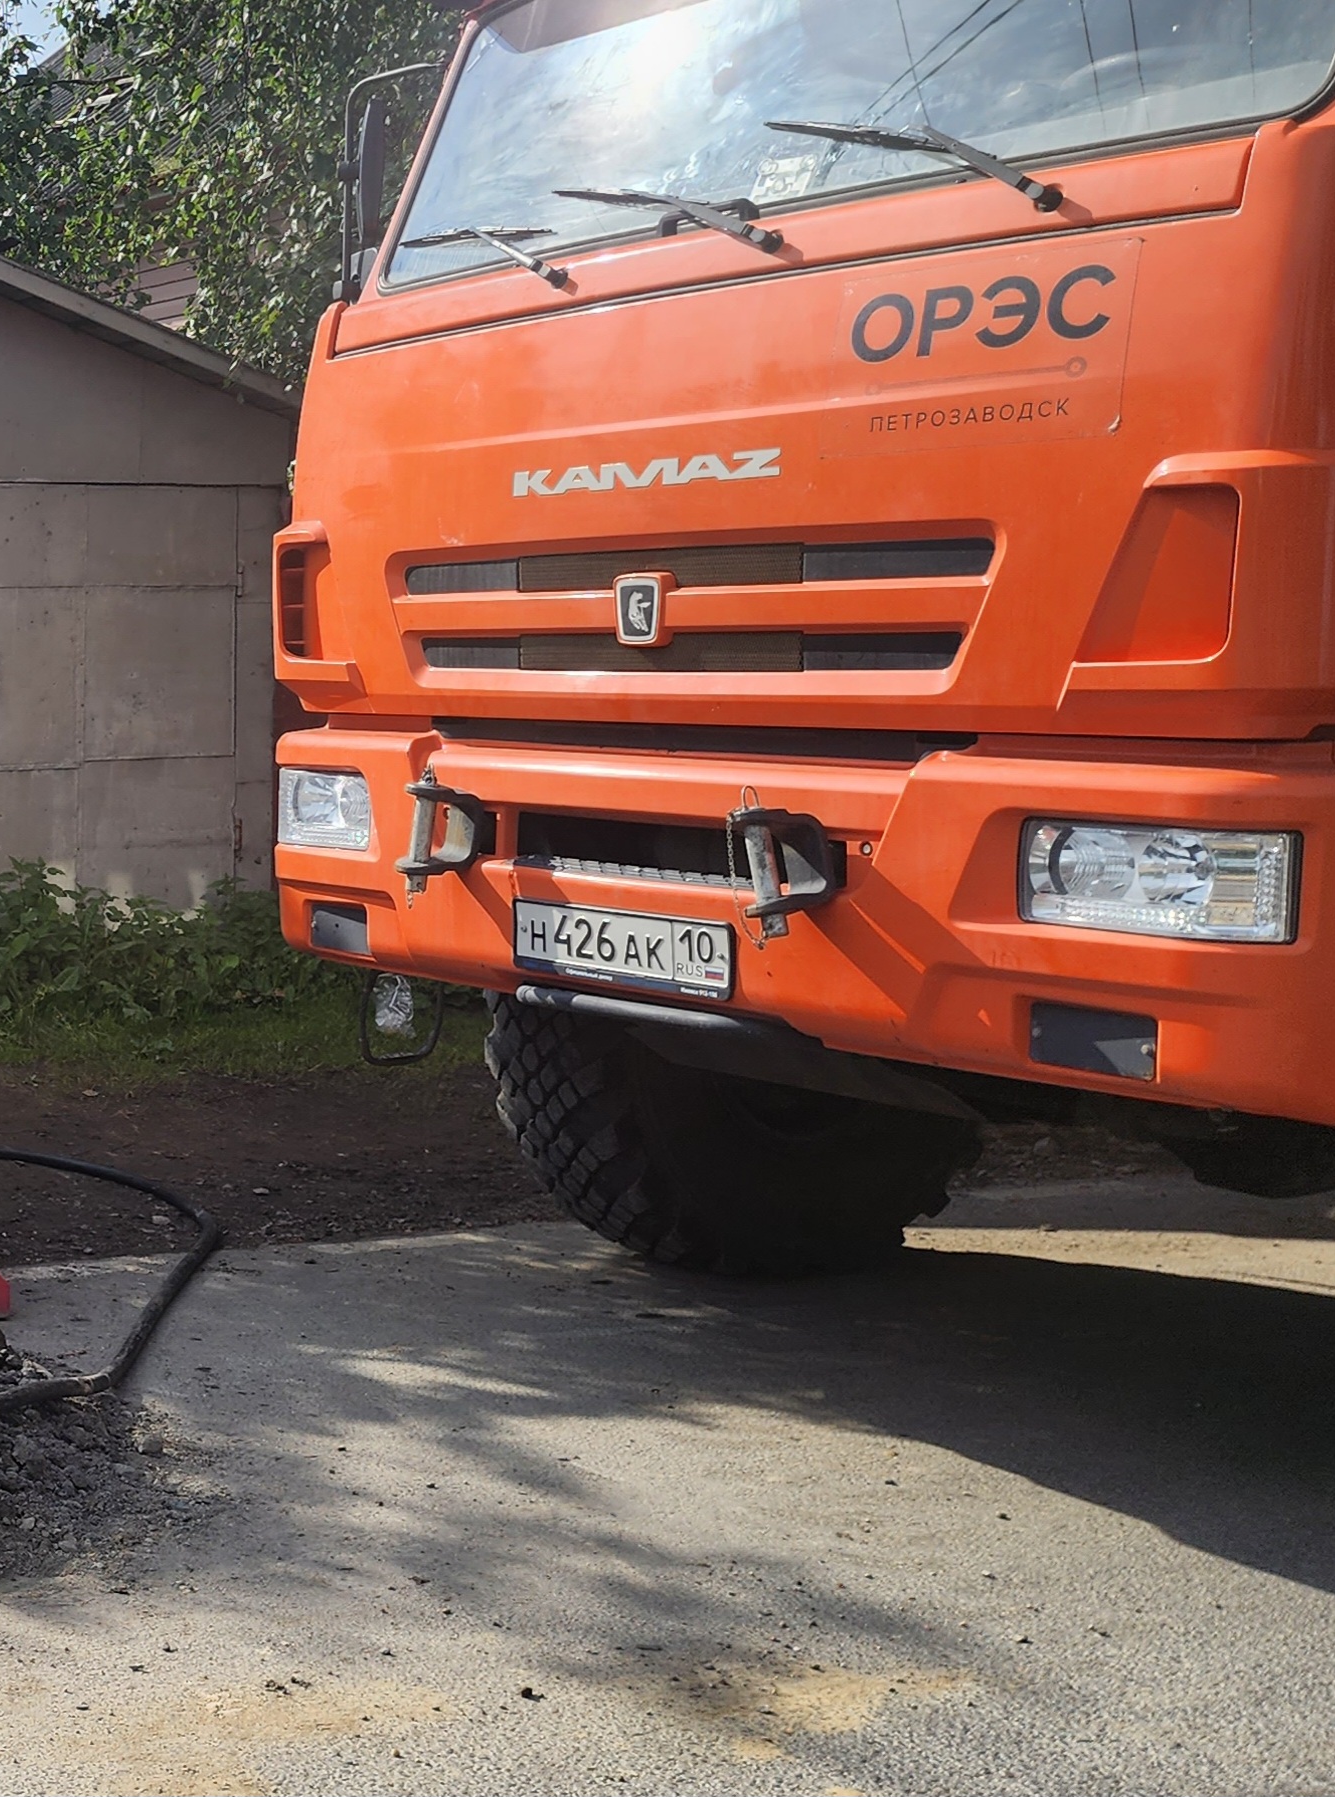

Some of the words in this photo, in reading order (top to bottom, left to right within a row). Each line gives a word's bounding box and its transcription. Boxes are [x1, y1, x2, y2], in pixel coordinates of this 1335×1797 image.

[851, 264, 1116, 364] ОРЭС
[869, 398, 1070, 433] ПЕТРОЗАВОДСК
[513, 447, 782, 497] KAMAZ
[678, 926, 714, 964] 10
[676, 961, 704, 978] RUS
